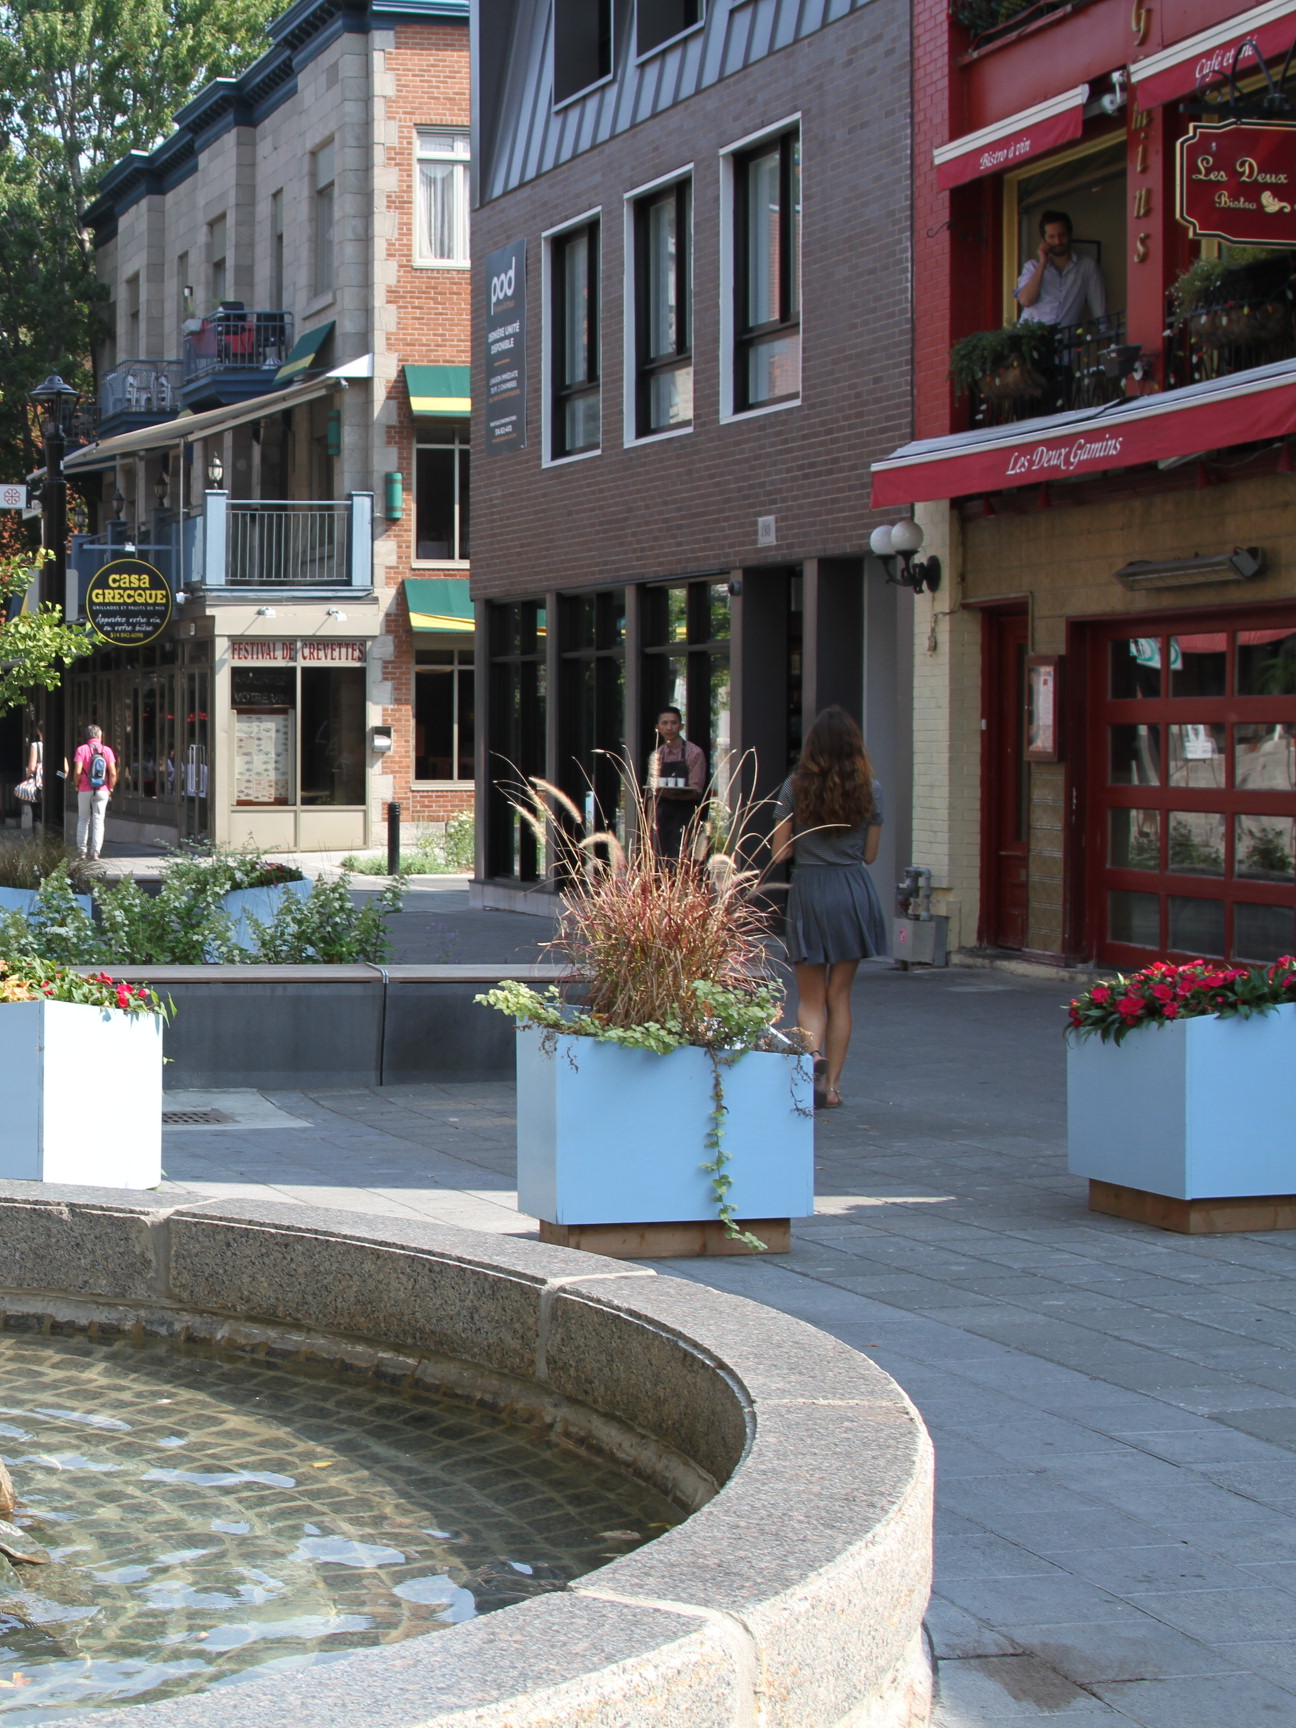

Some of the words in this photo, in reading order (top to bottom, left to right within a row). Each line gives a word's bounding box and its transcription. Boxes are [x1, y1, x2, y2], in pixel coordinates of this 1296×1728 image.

[1195, 50, 1222, 82] Café
[1223, 48, 1235, 65] et
[979, 149, 1007, 170] Bistro
[1008, 142, 1015, 159] à
[1015, 137, 1031, 156] vin
[1192, 155, 1228, 182] Les
[1236, 157, 1289, 183] Deux
[1215, 190, 1257, 209] Bistro
[491, 256, 516, 316] pod
[1005, 452, 1031, 475] Les
[1031, 446, 1069, 470] Deux
[1069, 434, 1123, 471] Gamins
[91, 589, 167, 604] GRECQUE
[231, 641, 278, 660] FESTIVAL
[281, 641, 295, 660] DE
[301, 642, 364, 661] CREVETTES
